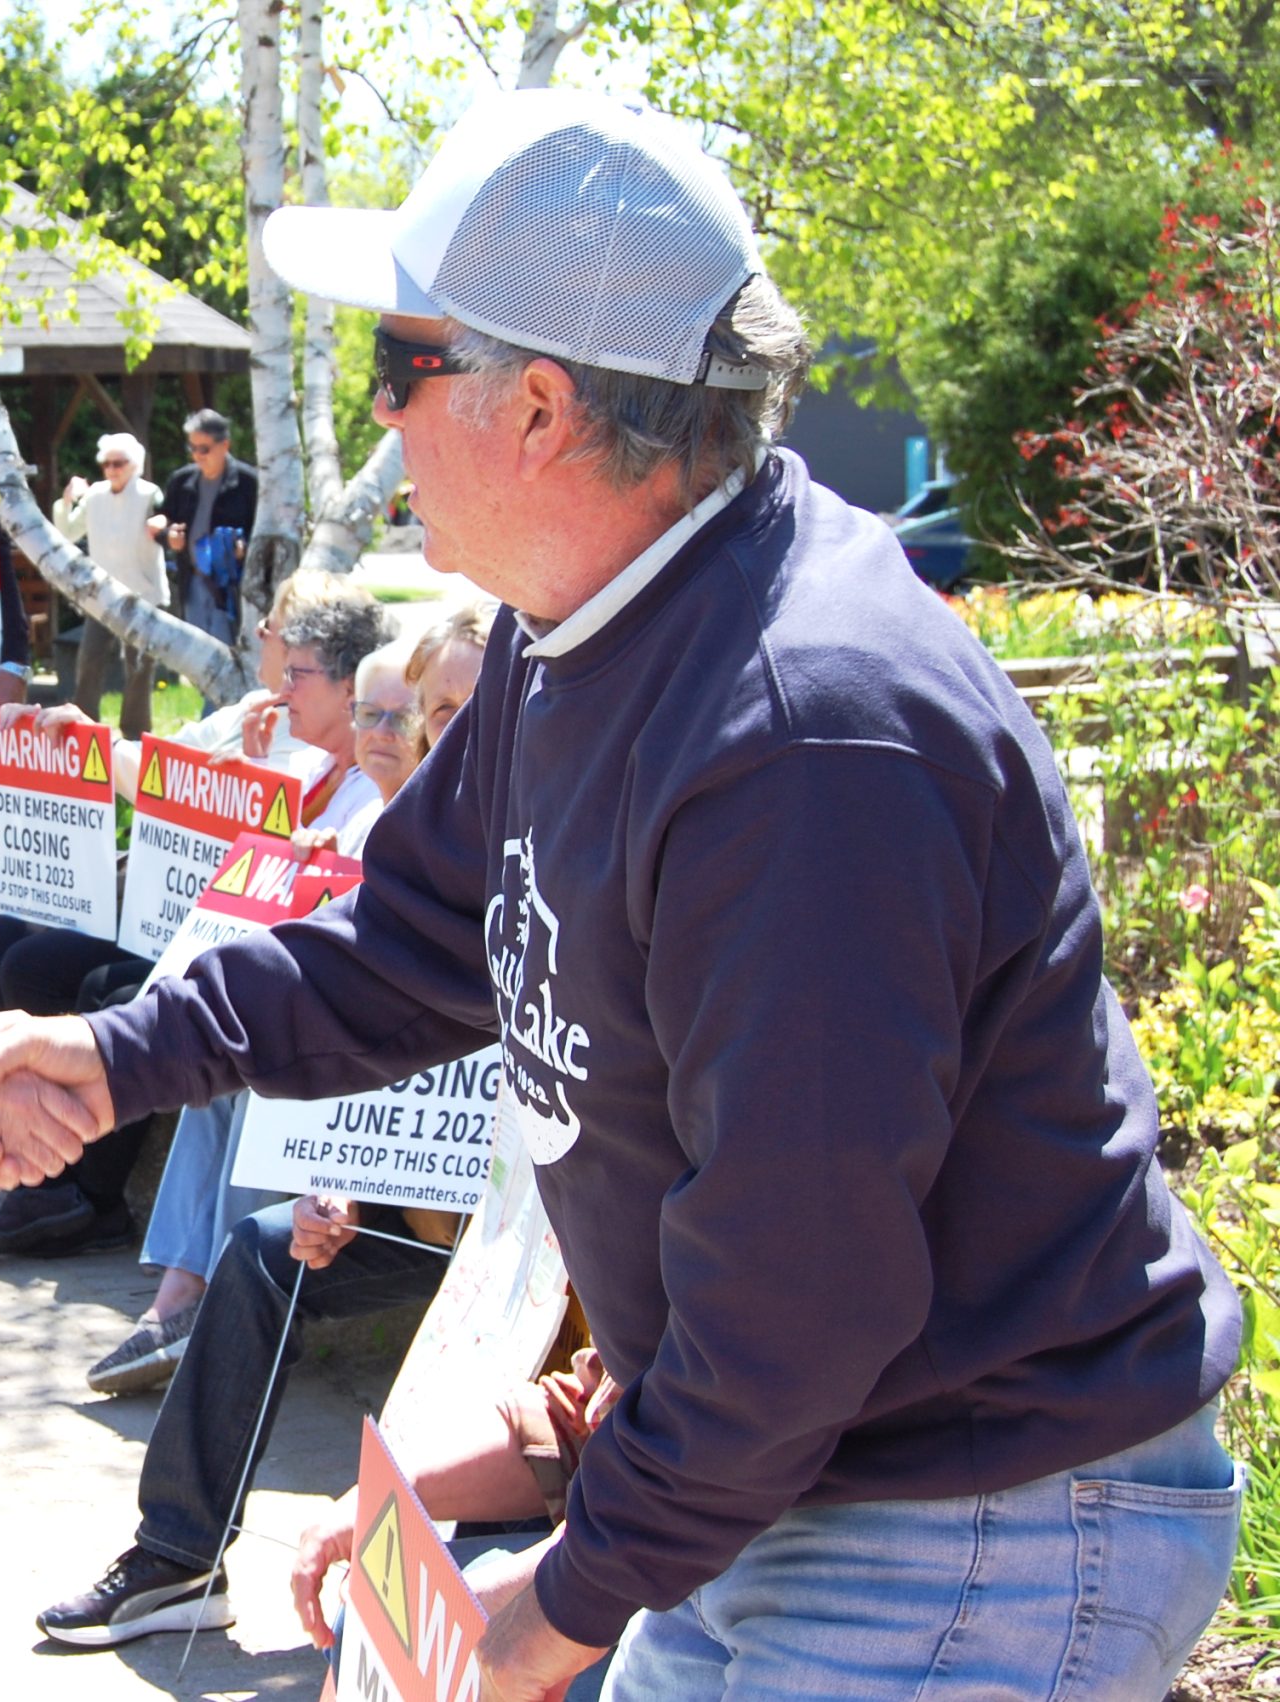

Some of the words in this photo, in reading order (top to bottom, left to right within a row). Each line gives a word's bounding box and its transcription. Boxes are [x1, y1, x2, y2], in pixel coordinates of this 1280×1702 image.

[166, 757, 264, 827] WARNING
[24, 798, 104, 830] EMERGENCY
[3, 824, 70, 860] CLOSING
[139, 821, 190, 858] MINDEN
[1, 856, 33, 880] JUNE
[35, 865, 42, 882] 1
[45, 866, 75, 889] 2023
[0, 902, 77, 927] www.mindenmatters.com
[8, 883, 29, 900] STOP
[31, 888, 50, 905] THIS
[52, 893, 92, 914] CLOSURE
[140, 920, 161, 941] HELP
[510, 977, 590, 1082] Lake
[326, 1101, 404, 1138] JUNE
[410, 1108, 425, 1139] 1
[283, 1138, 333, 1161] HELP
[336, 1144, 387, 1168] STOP
[393, 1149, 436, 1175] THIS
[310, 1173, 484, 1205] www.mindenmatters.co
